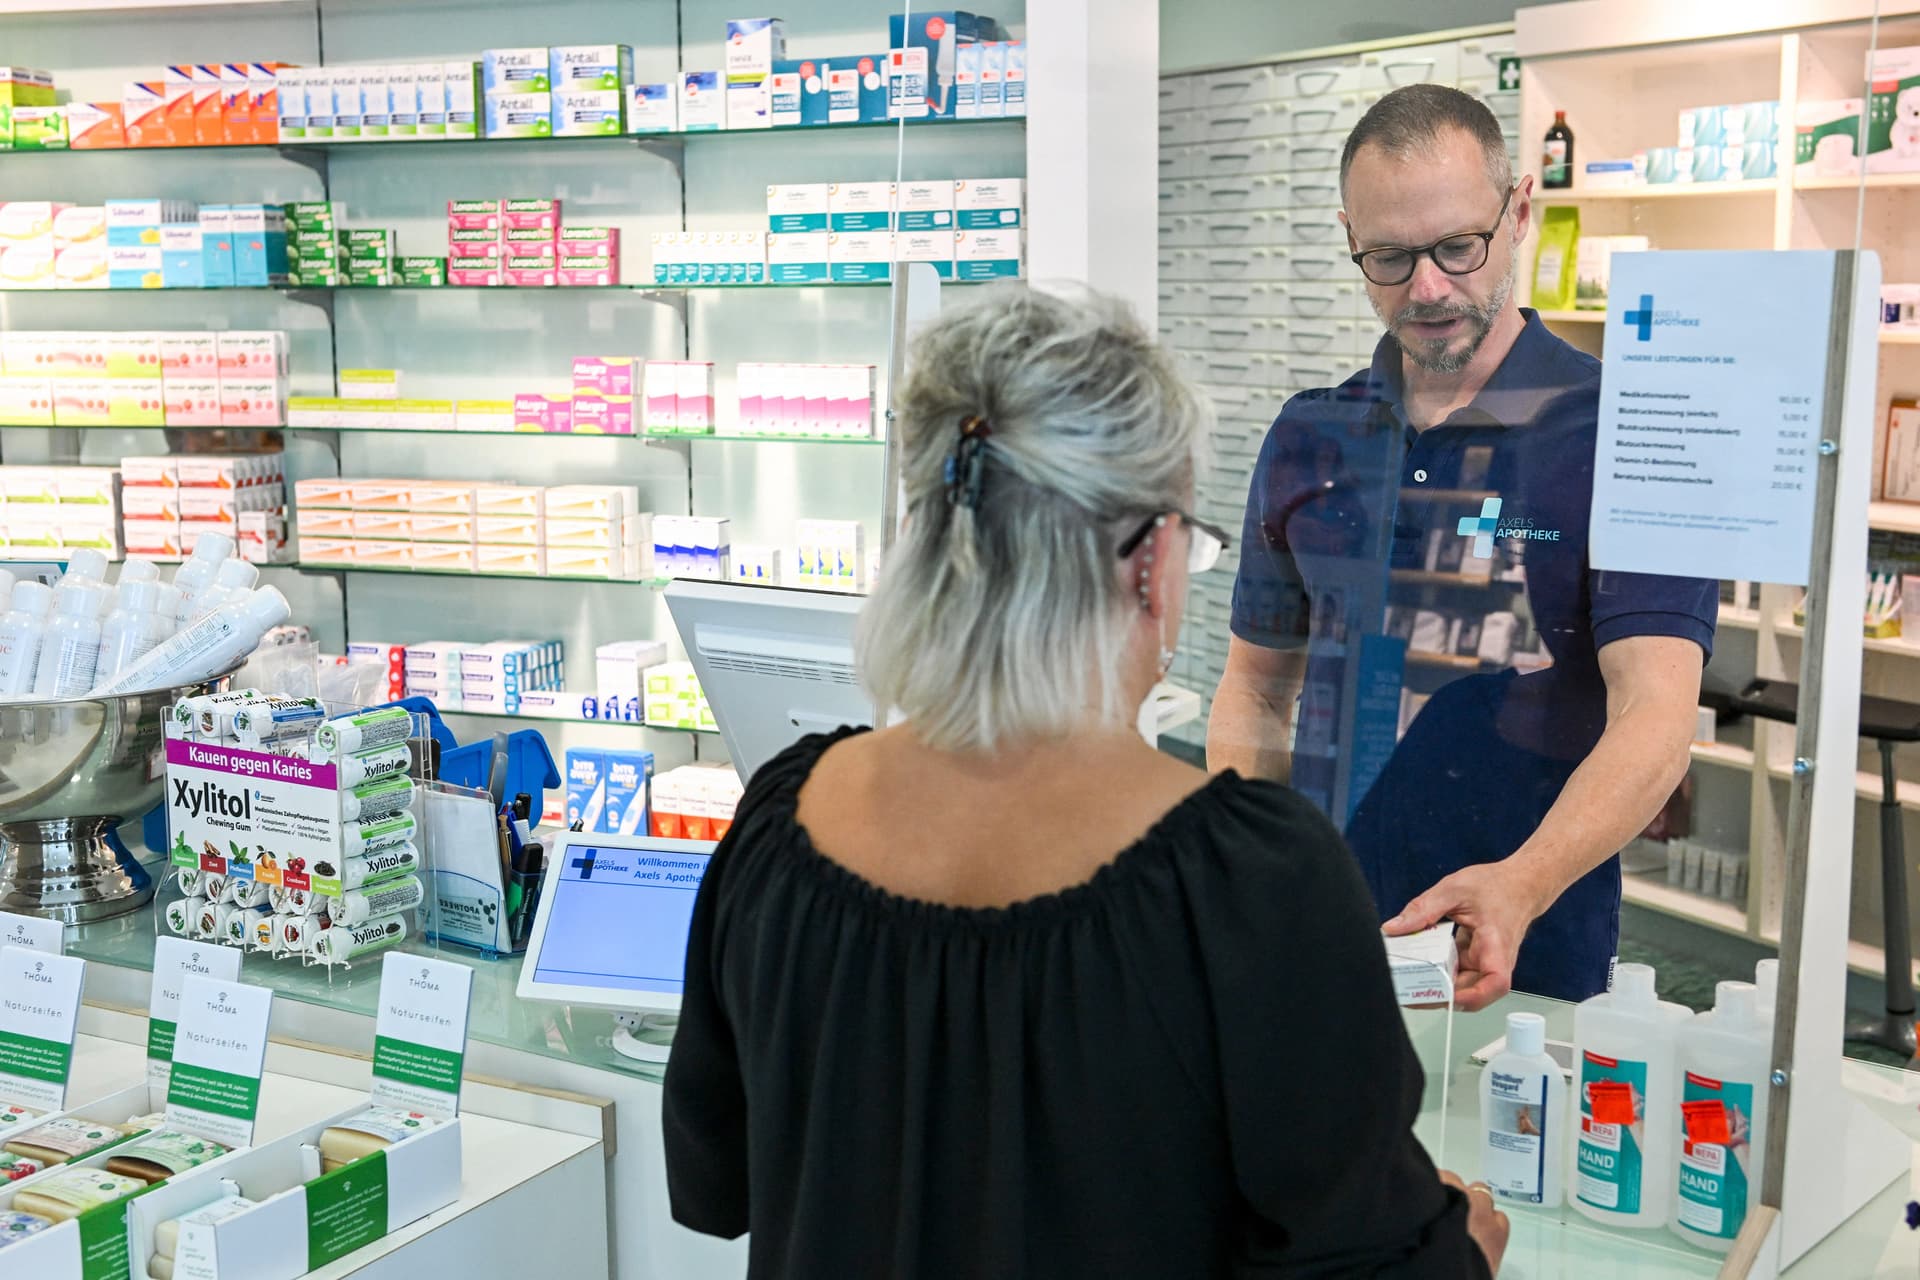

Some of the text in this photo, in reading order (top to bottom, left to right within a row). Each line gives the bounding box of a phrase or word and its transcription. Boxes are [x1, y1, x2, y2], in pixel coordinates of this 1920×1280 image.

[1654, 319, 1700, 327] APOTHEKE
[1498, 518, 1534, 528] AXELS
[1496, 528, 1560, 541] APOTHEKE
[189, 746, 312, 780] Kauen gegen Karies
[364, 760, 394, 778] Xylitol
[173, 778, 251, 819] Xylitol
[206, 816, 252, 832] Chewing Gum
[366, 854, 400, 873] Xylitol
[594, 864, 629, 872] APOTHEKE
[638, 858, 700, 870] Willkommen
[286, 876, 307, 886] Cranberry
[634, 870, 661, 880] Axels
[7, 934, 34, 946] THOMA
[352, 925, 385, 945] Xylitol
[180, 962, 211, 976] THOMA
[24, 972, 53, 984] THOMA
[408, 978, 440, 992] THOMA
[5, 1000, 63, 1018] Naturseifen
[207, 1002, 238, 1016] THOMA
[390, 1006, 453, 1027] Naturseifen
[186, 1031, 248, 1051] Naturseifen
[1592, 1124, 1613, 1137] WEPA
[1580, 1146, 1615, 1169] HAND
[1695, 1147, 1718, 1161] WEPA
[1681, 1170, 1719, 1194] HAND
